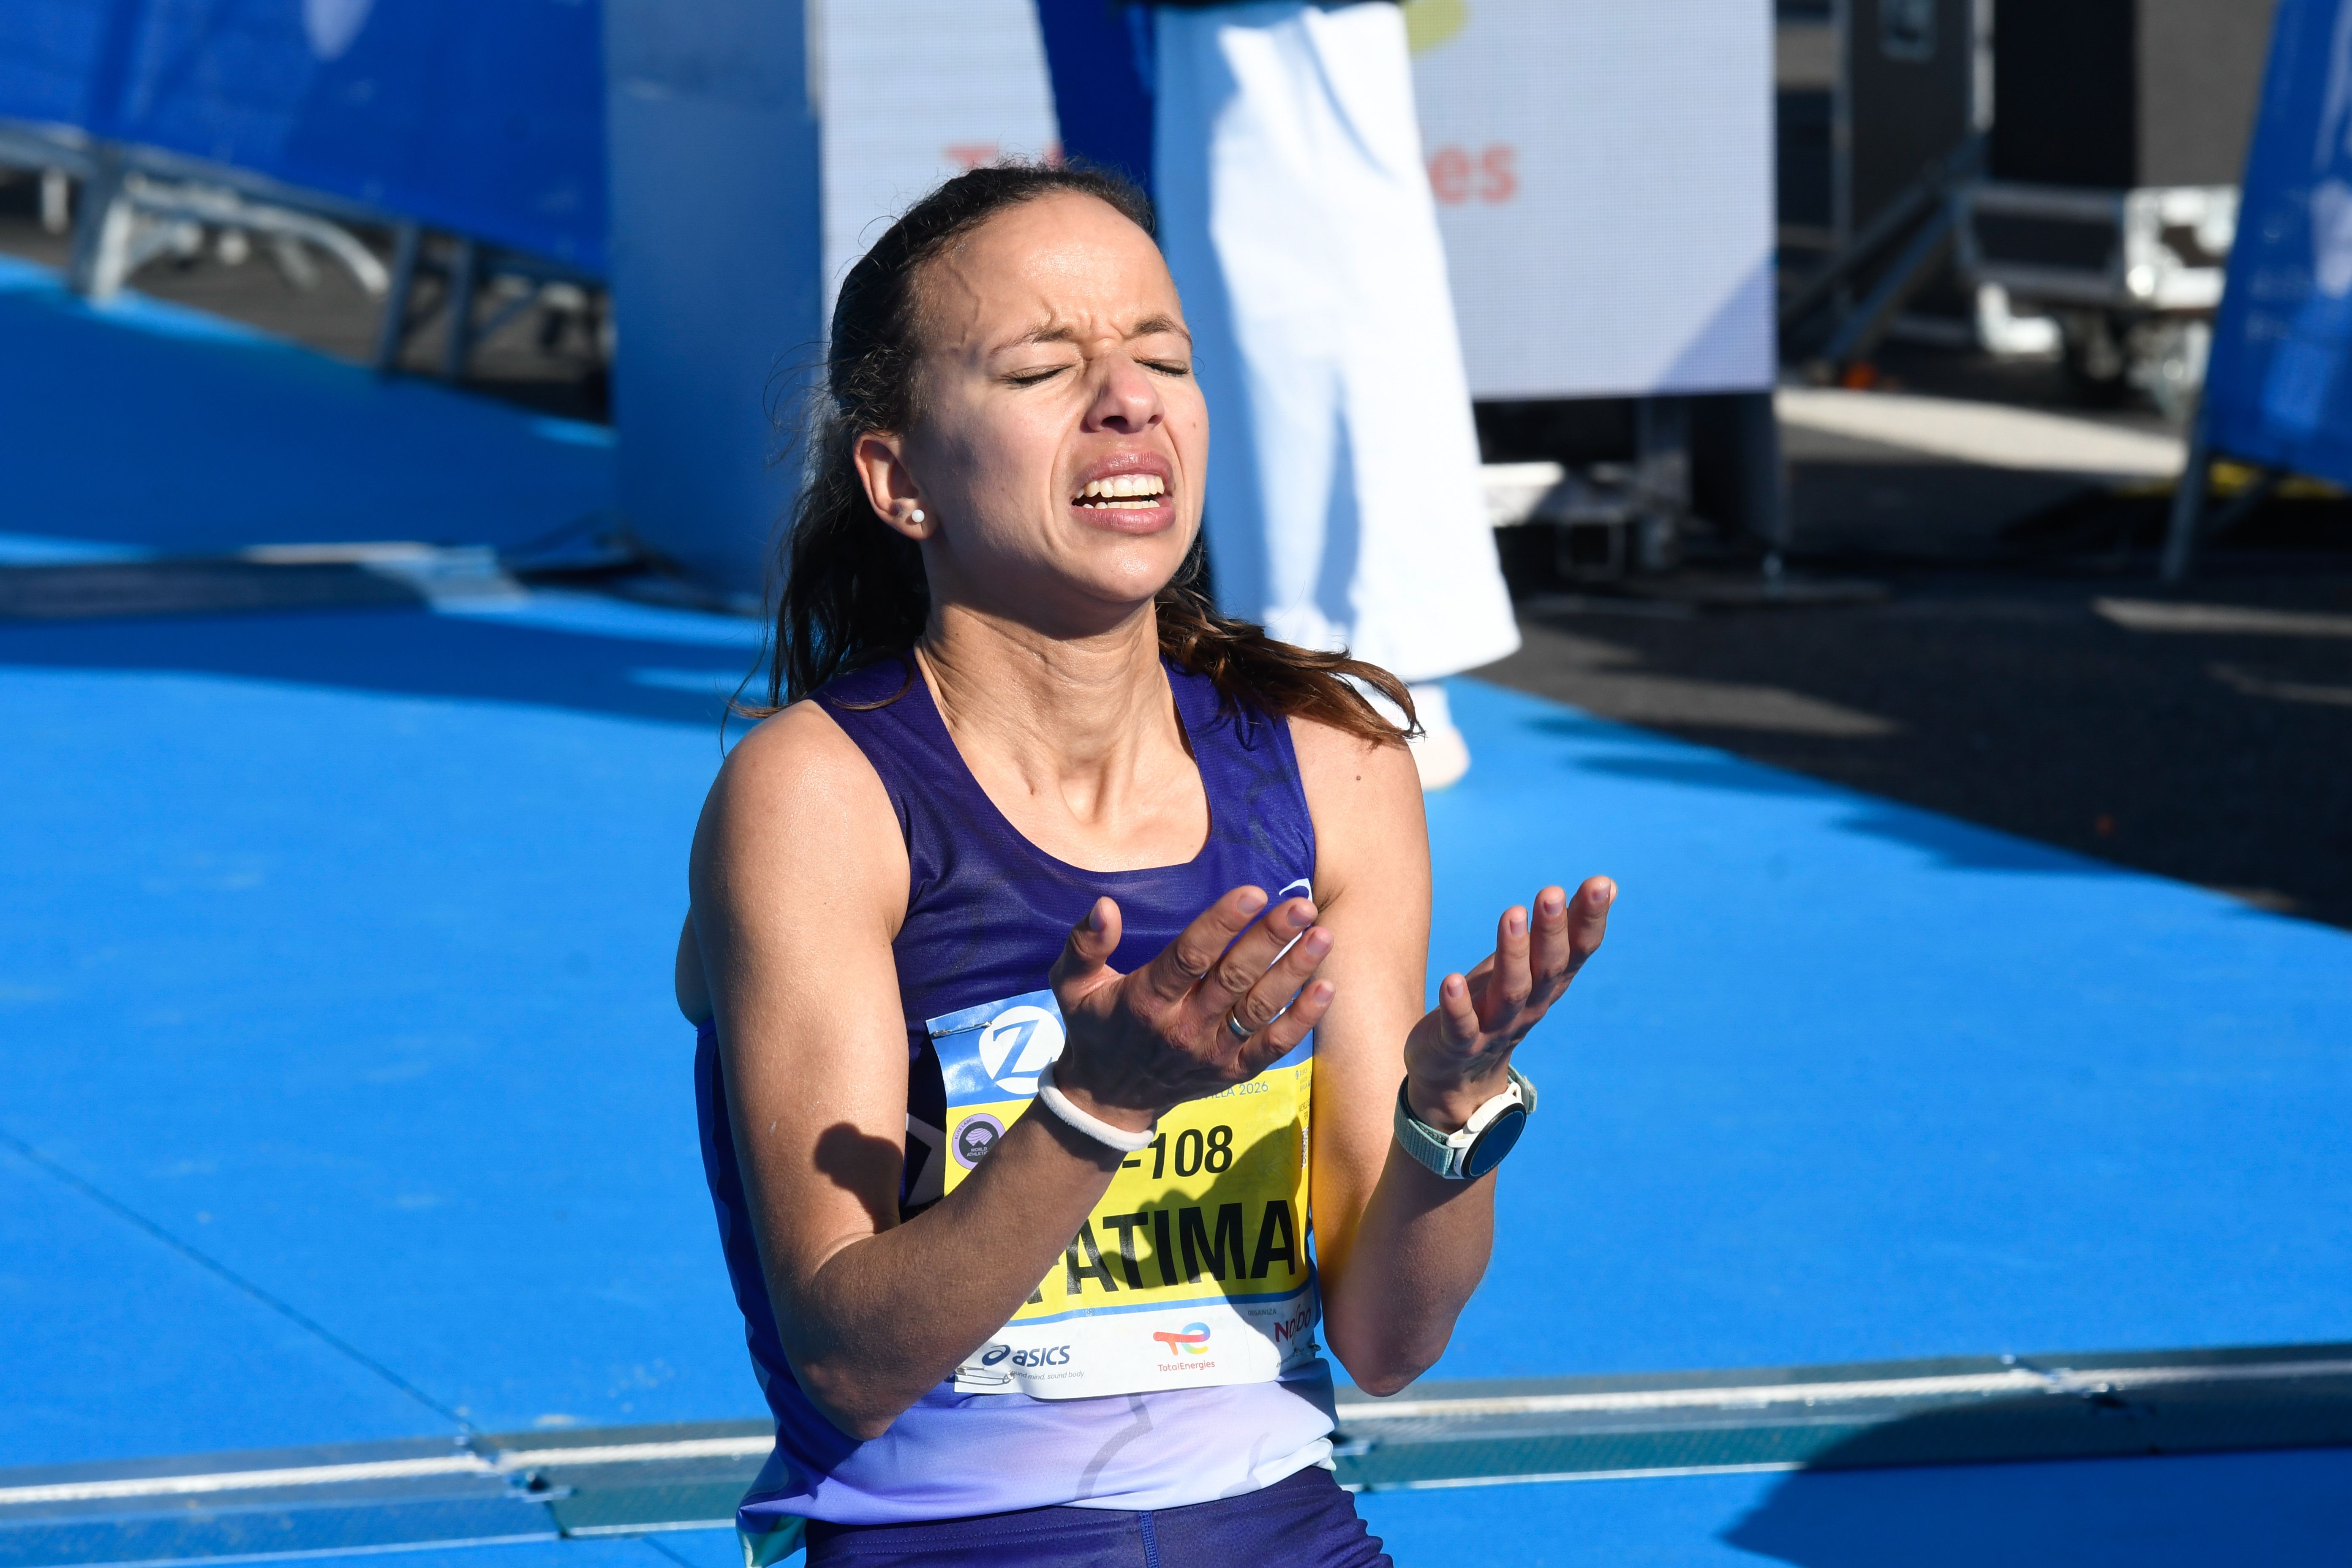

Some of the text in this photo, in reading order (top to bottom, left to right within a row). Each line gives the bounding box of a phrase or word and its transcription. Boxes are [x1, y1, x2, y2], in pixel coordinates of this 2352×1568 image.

[1239, 1081, 1269, 1095] 2026
[961, 1118, 974, 1127] LABEL
[1026, 1200, 1296, 1304] ATIMA
[1248, 1308, 1277, 1316] ORGANIZA
[1157, 1360, 1215, 1372] TotalEnergies
[1068, 1370, 1085, 1378] body
